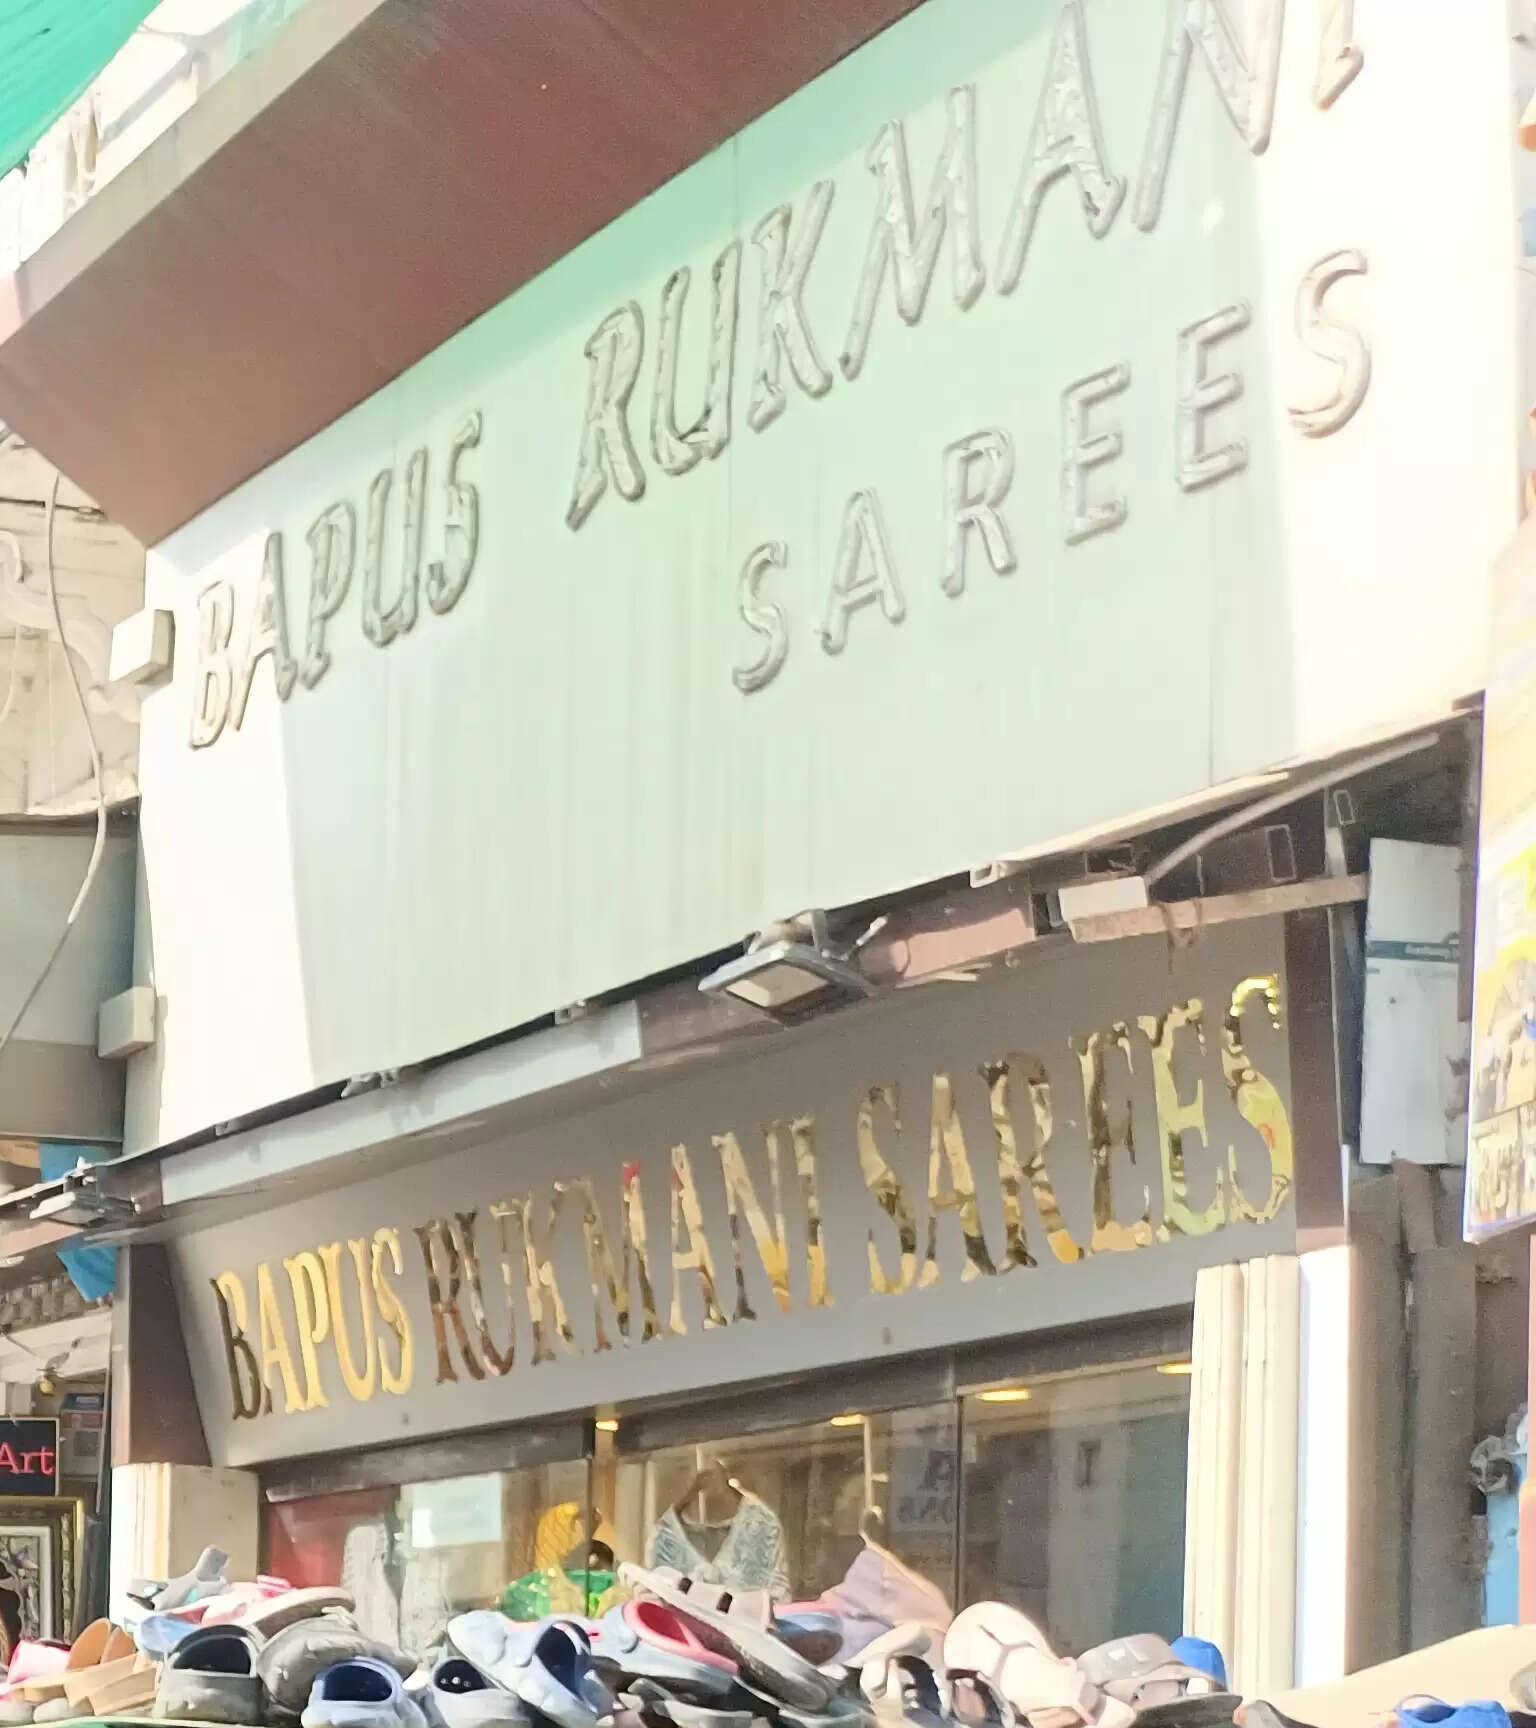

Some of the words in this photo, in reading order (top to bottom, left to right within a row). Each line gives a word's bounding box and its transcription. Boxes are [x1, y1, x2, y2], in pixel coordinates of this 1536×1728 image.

[188, 410, 483, 751] BAPUS
[732, 247, 1373, 694] SAREES
[209, 1224, 415, 1422] BAPUS
[413, 1113, 835, 1386] RUKMANI
[855, 973, 1296, 1296] SAREES
